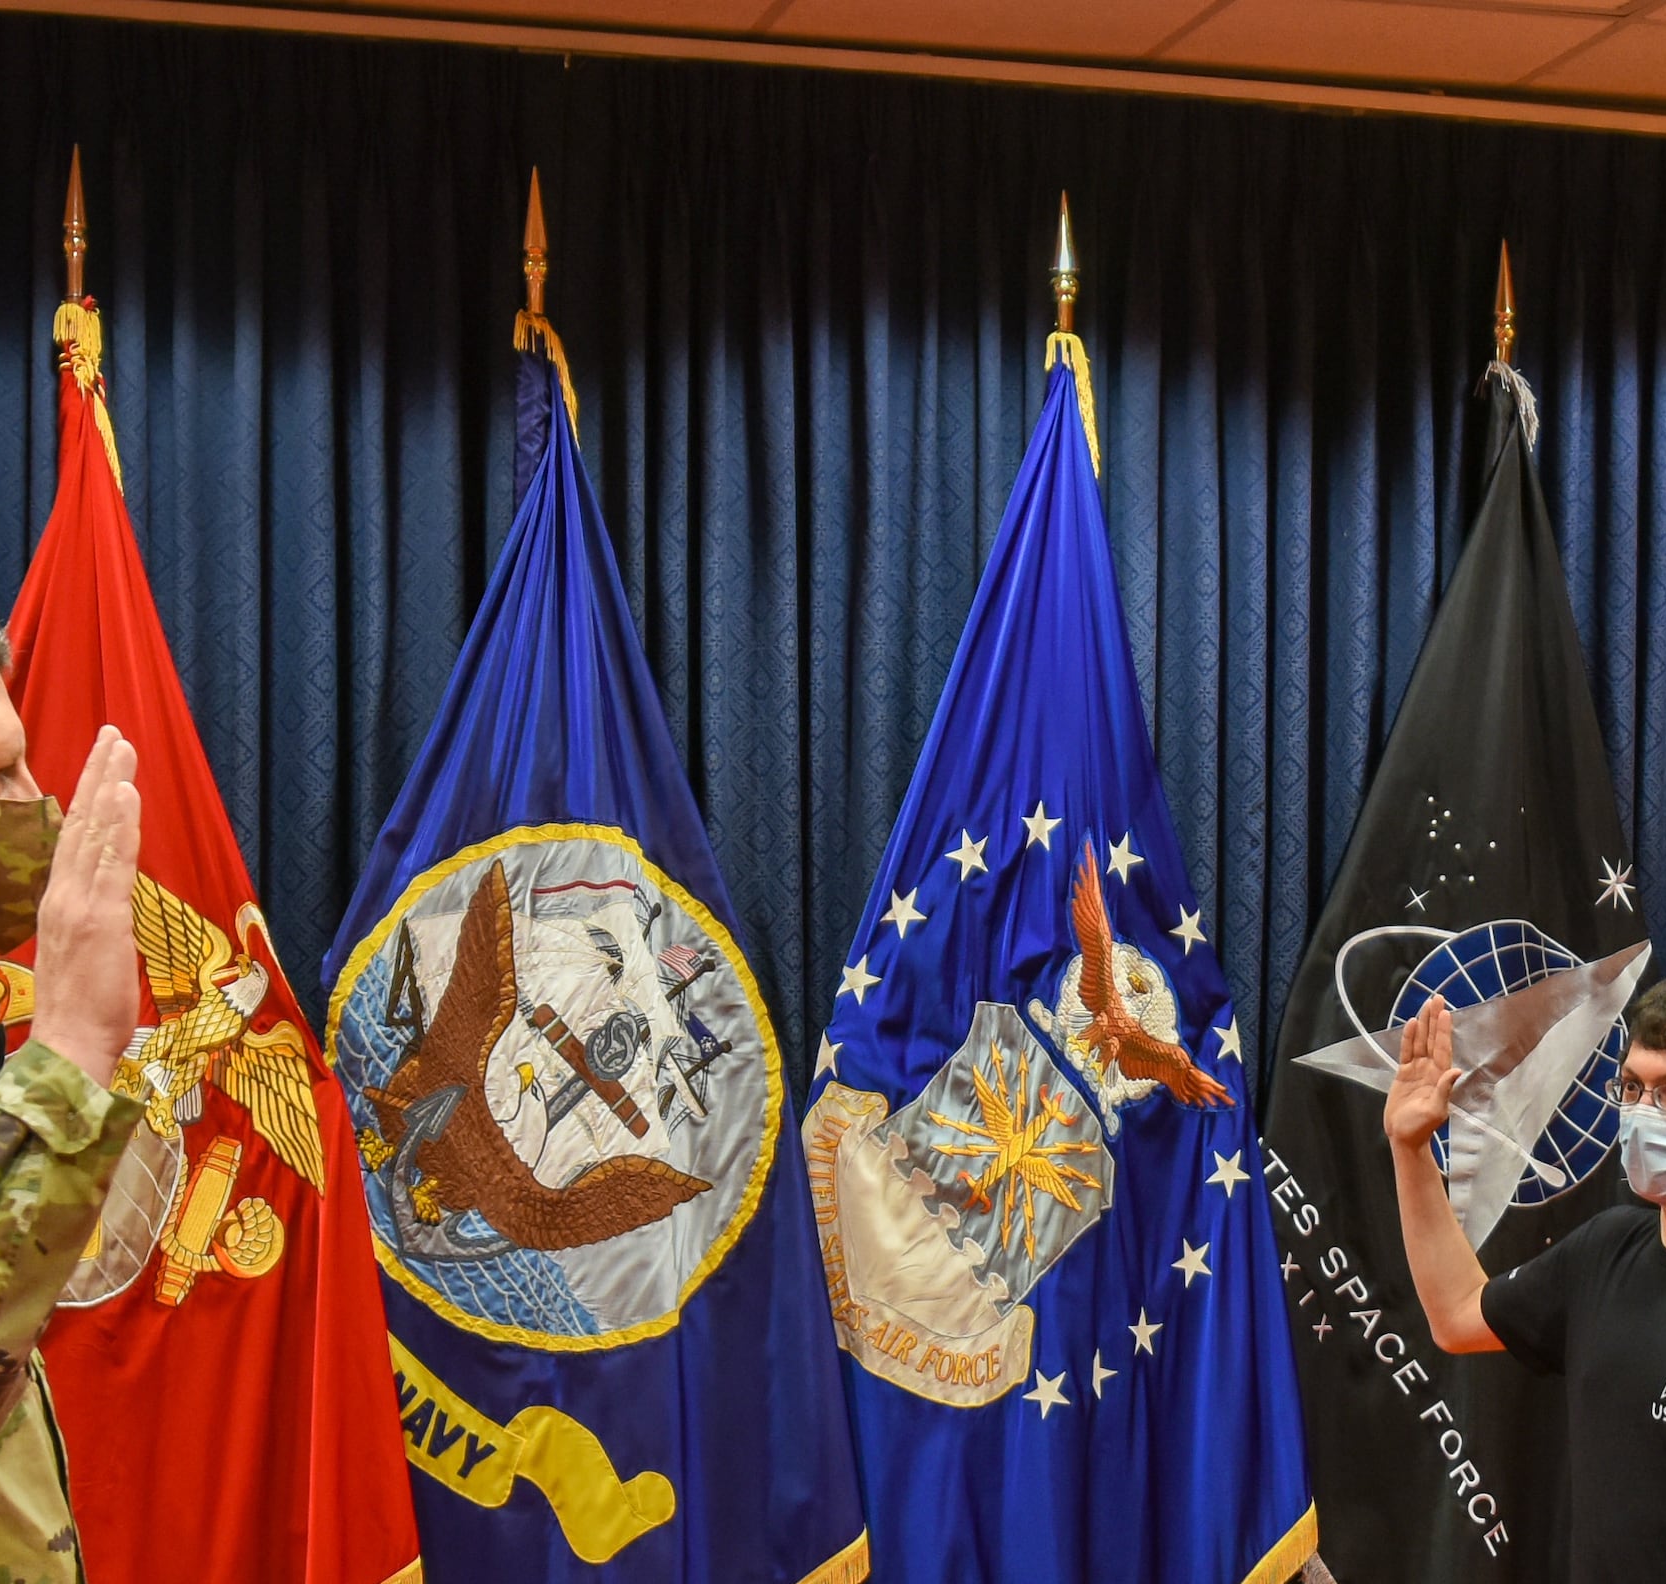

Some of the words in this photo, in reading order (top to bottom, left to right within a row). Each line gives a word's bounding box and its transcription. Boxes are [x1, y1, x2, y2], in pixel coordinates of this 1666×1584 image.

[808, 1115, 850, 1224] UNITED
[822, 1234, 869, 1331] STATES
[864, 1320, 918, 1365] AIR
[916, 1344, 1001, 1387] FORCE
[1258, 1137, 1320, 1237] TES
[1320, 1246, 1429, 1395] SPACE
[1420, 1400, 1509, 1557] FORCE
[394, 1371, 497, 1479] NAVY
